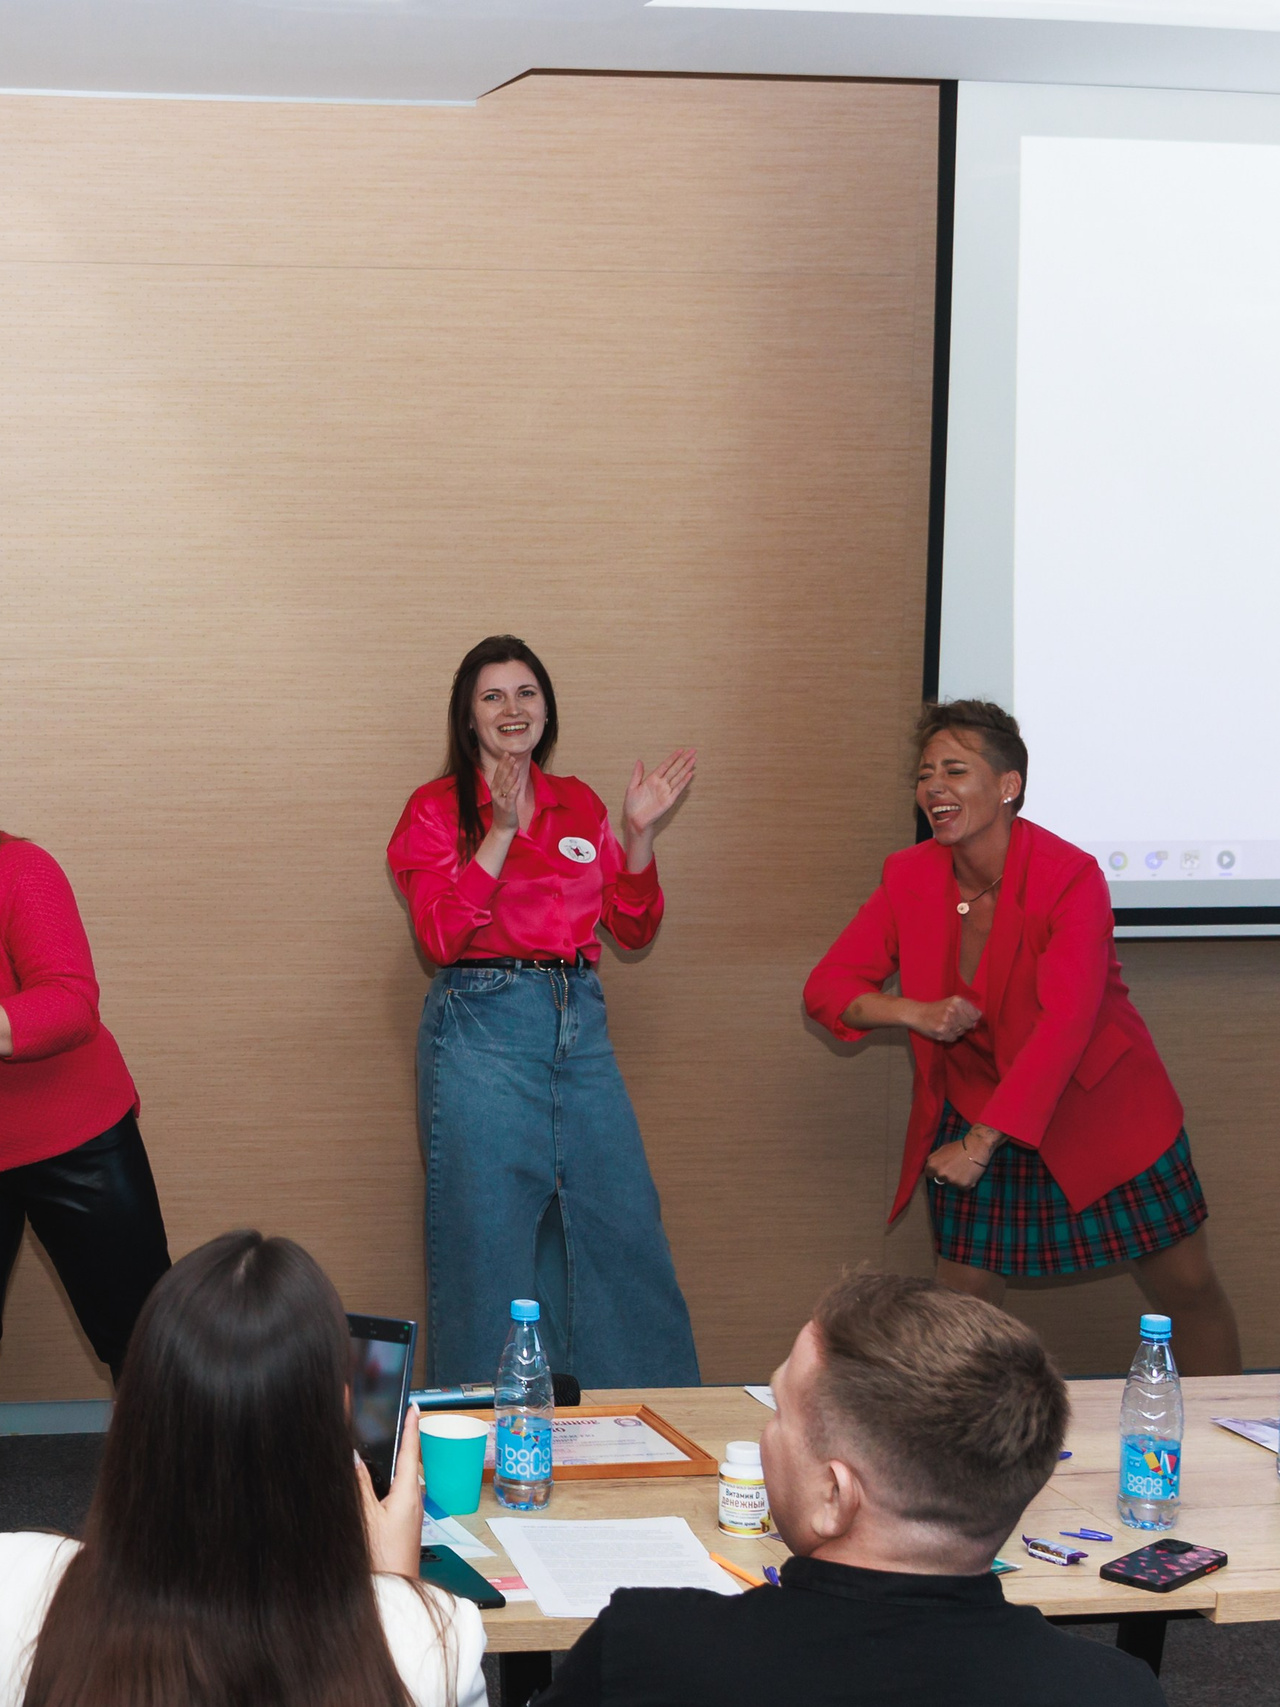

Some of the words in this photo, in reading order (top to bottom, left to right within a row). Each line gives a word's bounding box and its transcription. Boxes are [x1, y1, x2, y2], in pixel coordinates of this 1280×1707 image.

[505, 1443, 550, 1462] bona
[505, 1460, 550, 1478] aqua
[1127, 1472, 1163, 1487] bona
[725, 1488, 754, 1499] Витамин
[1127, 1482, 1163, 1496] aqua
